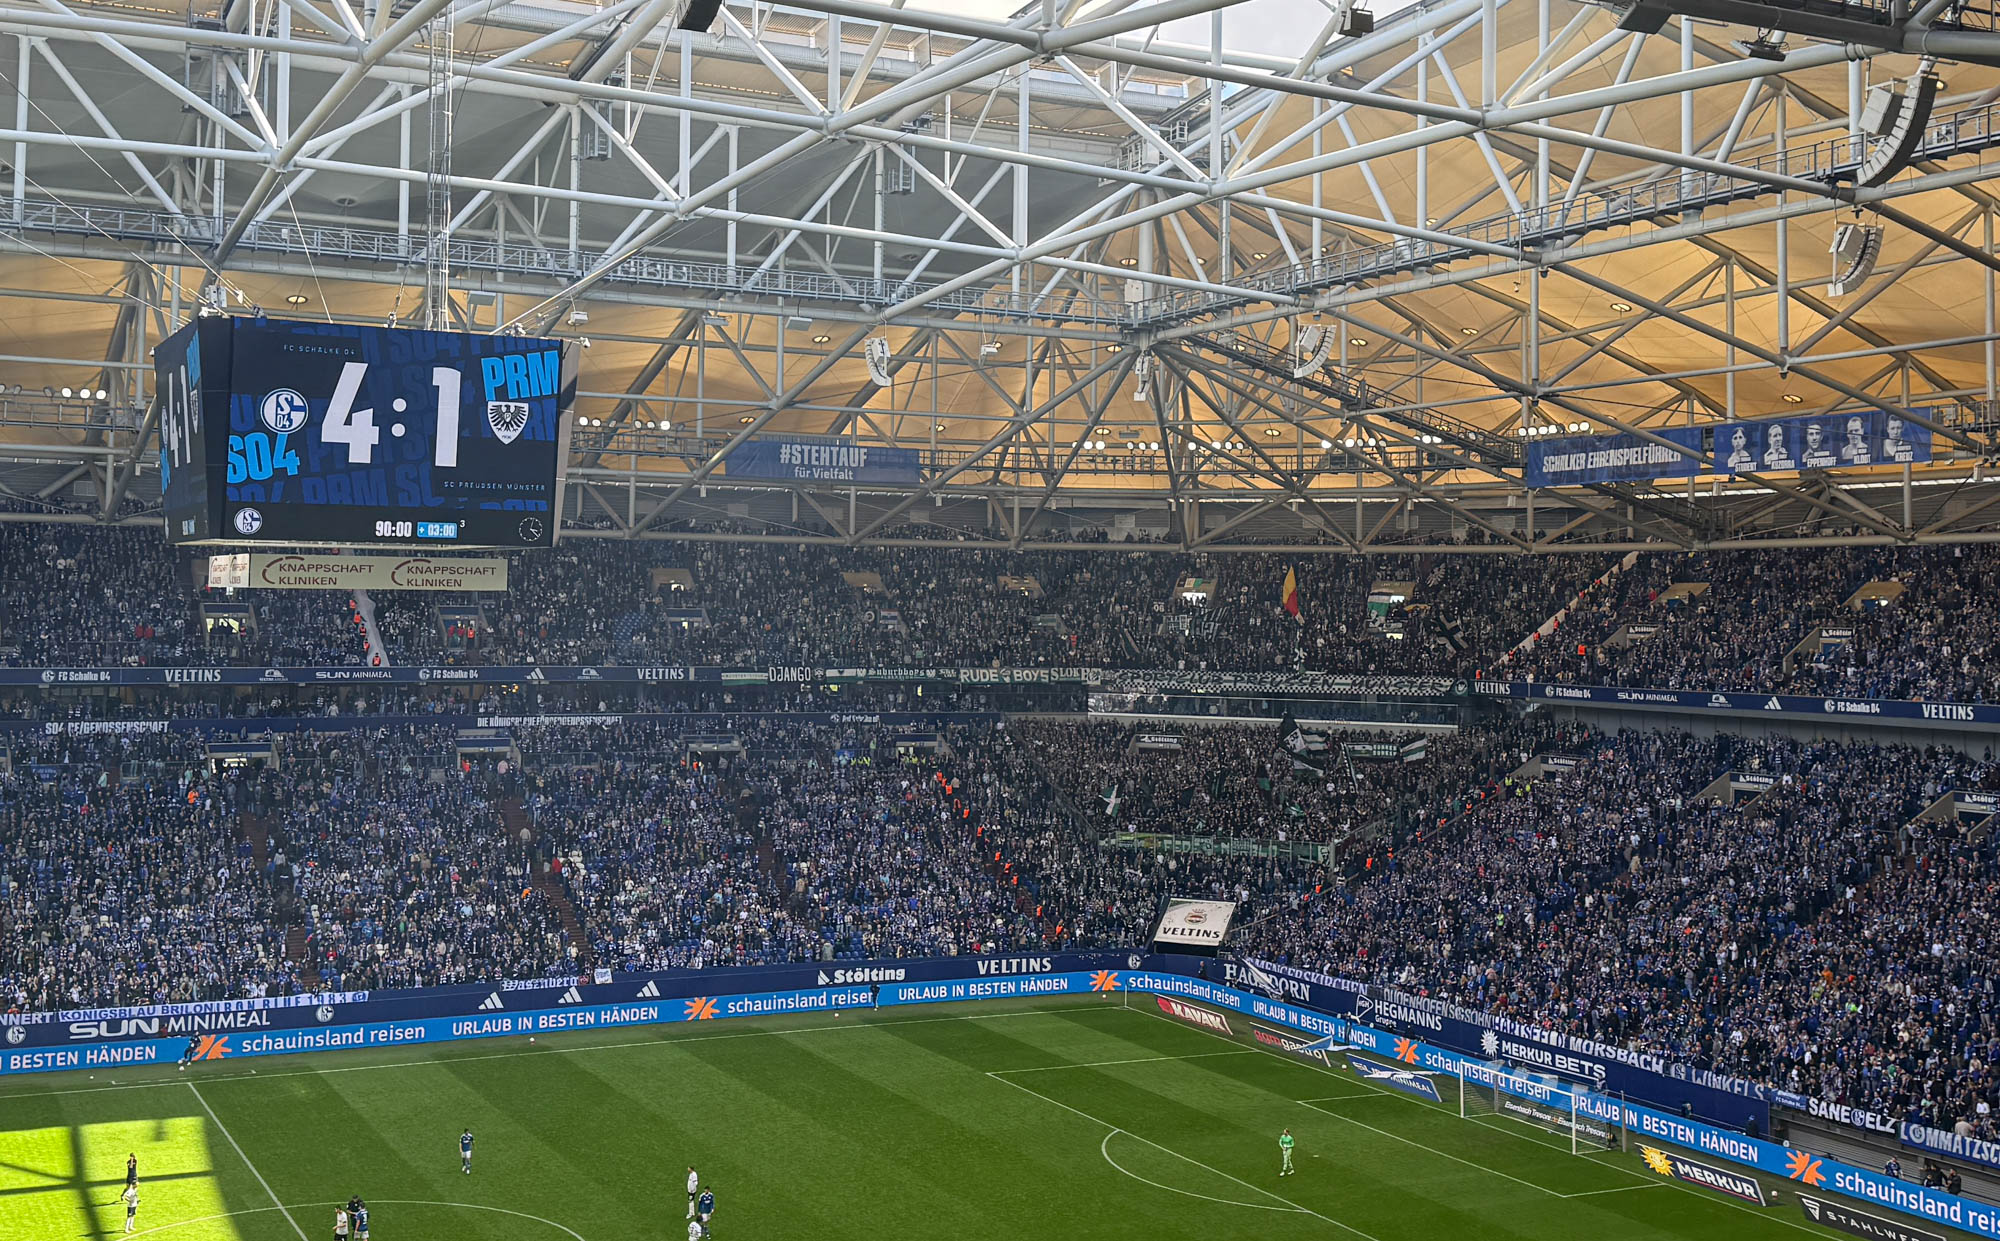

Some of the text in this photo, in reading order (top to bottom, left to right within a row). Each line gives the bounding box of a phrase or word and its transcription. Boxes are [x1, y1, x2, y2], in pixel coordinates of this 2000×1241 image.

[284, 344, 355, 356] FC SCHALKE 04
[481, 350, 560, 402] PRM
[780, 444, 867, 468] #STEHTAUF
[1543, 452, 1586, 472] SCHALKER
[794, 468, 853, 480] für Vielfalt
[507, 483, 545, 491] MÜNSTER
[376, 521, 412, 537] 90:00
[428, 524, 455, 536] 03:00
[460, 520, 466, 528] 3
[279, 564, 375, 575] KNAPPSCHAFT
[406, 565, 496, 577] KNAPPSCHAFT
[279, 576, 337, 586] KLINIKEN
[406, 576, 462, 587] KLINIKEN
[58, 671, 110, 681] FC Schalke 04
[164, 670, 222, 682] VELTINS
[433, 670, 478, 679] FC Schalke 04
[637, 668, 684, 680] VELTINS
[769, 666, 811, 682] DJANGO
[960, 669, 998, 682] RUDE
[1013, 669, 1049, 682] BOYS
[1232, 674, 1334, 688] PREUSSEN
[1475, 682, 1510, 694] VELTINS
[1563, 690, 1582, 698] Schalke
[1617, 692, 1678, 702] SUN MINIMEAL
[1837, 702, 1880, 714] FC Schalke 04
[1922, 704, 1974, 720] VELTINS
[478, 717, 488, 727] DIE
[1746, 774, 1774, 784] Stölting
[1162, 927, 1220, 939] VELTINS
[977, 958, 1052, 975] VELTINS
[834, 968, 905, 984] Stölting
[1224, 963, 1310, 1002] HADORN
[898, 976, 1068, 1001] URLAUB IN BESTEN HÄNDEN
[1128, 975, 1240, 1008] schauinsland reisen
[728, 991, 827, 1014] schauinsland
[452, 1006, 658, 1036] URLAUB IN BESTEN HÄNDEN
[1171, 1000, 1223, 1032] KAVAK
[1375, 1000, 1442, 1031] HEGMANNS
[1375, 1014, 1397, 1028] Gruppe
[69, 1010, 270, 1040] SUN MINIMEAL
[1253, 1000, 1377, 1048] URLAUB IN BESTEN HNDEN
[242, 1025, 425, 1053] schauinsland reisen
[10, 1046, 156, 1070] BESTEN HÄNDEN
[1502, 1040, 1606, 1081] MERKUR BETS
[1570, 1036, 1664, 1074] MORSBACH
[1509, 1074, 1550, 1100] reisen
[1505, 1101, 1532, 1116] Eisenbach
[1808, 1098, 1851, 1123] SANE
[1865, 1112, 1897, 1134] ELZ
[1558, 1117, 1585, 1131] Eisenach
[1574, 1096, 1758, 1163] URLAUB IN BESTEN HÄNDEN
[1900, 1122, 2000, 1167] LOMMATZSC
[1676, 1161, 1758, 1199] MERKUR
[1835, 1172, 1961, 1224] schauinsland
